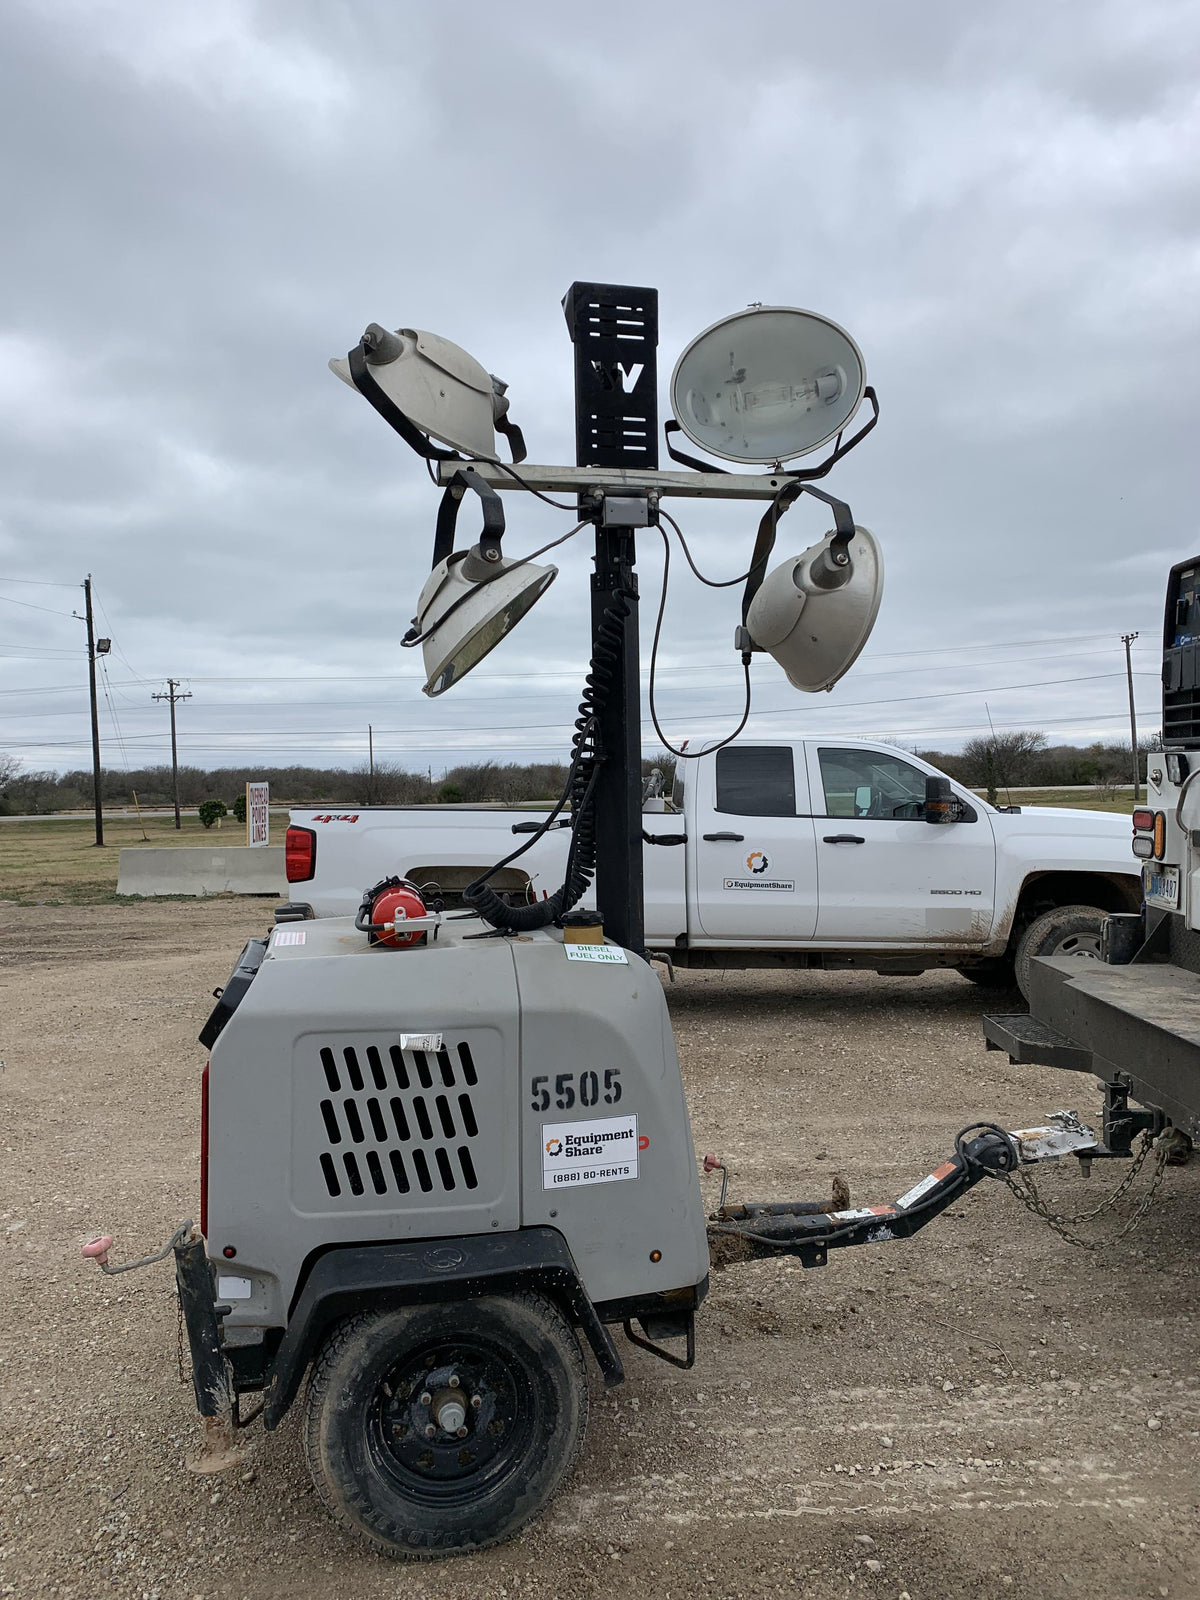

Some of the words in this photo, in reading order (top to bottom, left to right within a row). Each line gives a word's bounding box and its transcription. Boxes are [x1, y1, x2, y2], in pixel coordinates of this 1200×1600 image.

[252, 806, 267, 824] POWER
[252, 824, 267, 843] LINES
[734, 881, 793, 889] EquipmentShare
[570, 951, 596, 960] FUEL
[598, 953, 623, 961] ONLY
[577, 945, 612, 953] DIESEL
[531, 1068, 622, 1112] 5505
[565, 1128, 634, 1146] Equipment
[565, 1145, 603, 1158] Share
[553, 1172, 580, 1183] (888)
[583, 1166, 630, 1180] 80-RENTS
